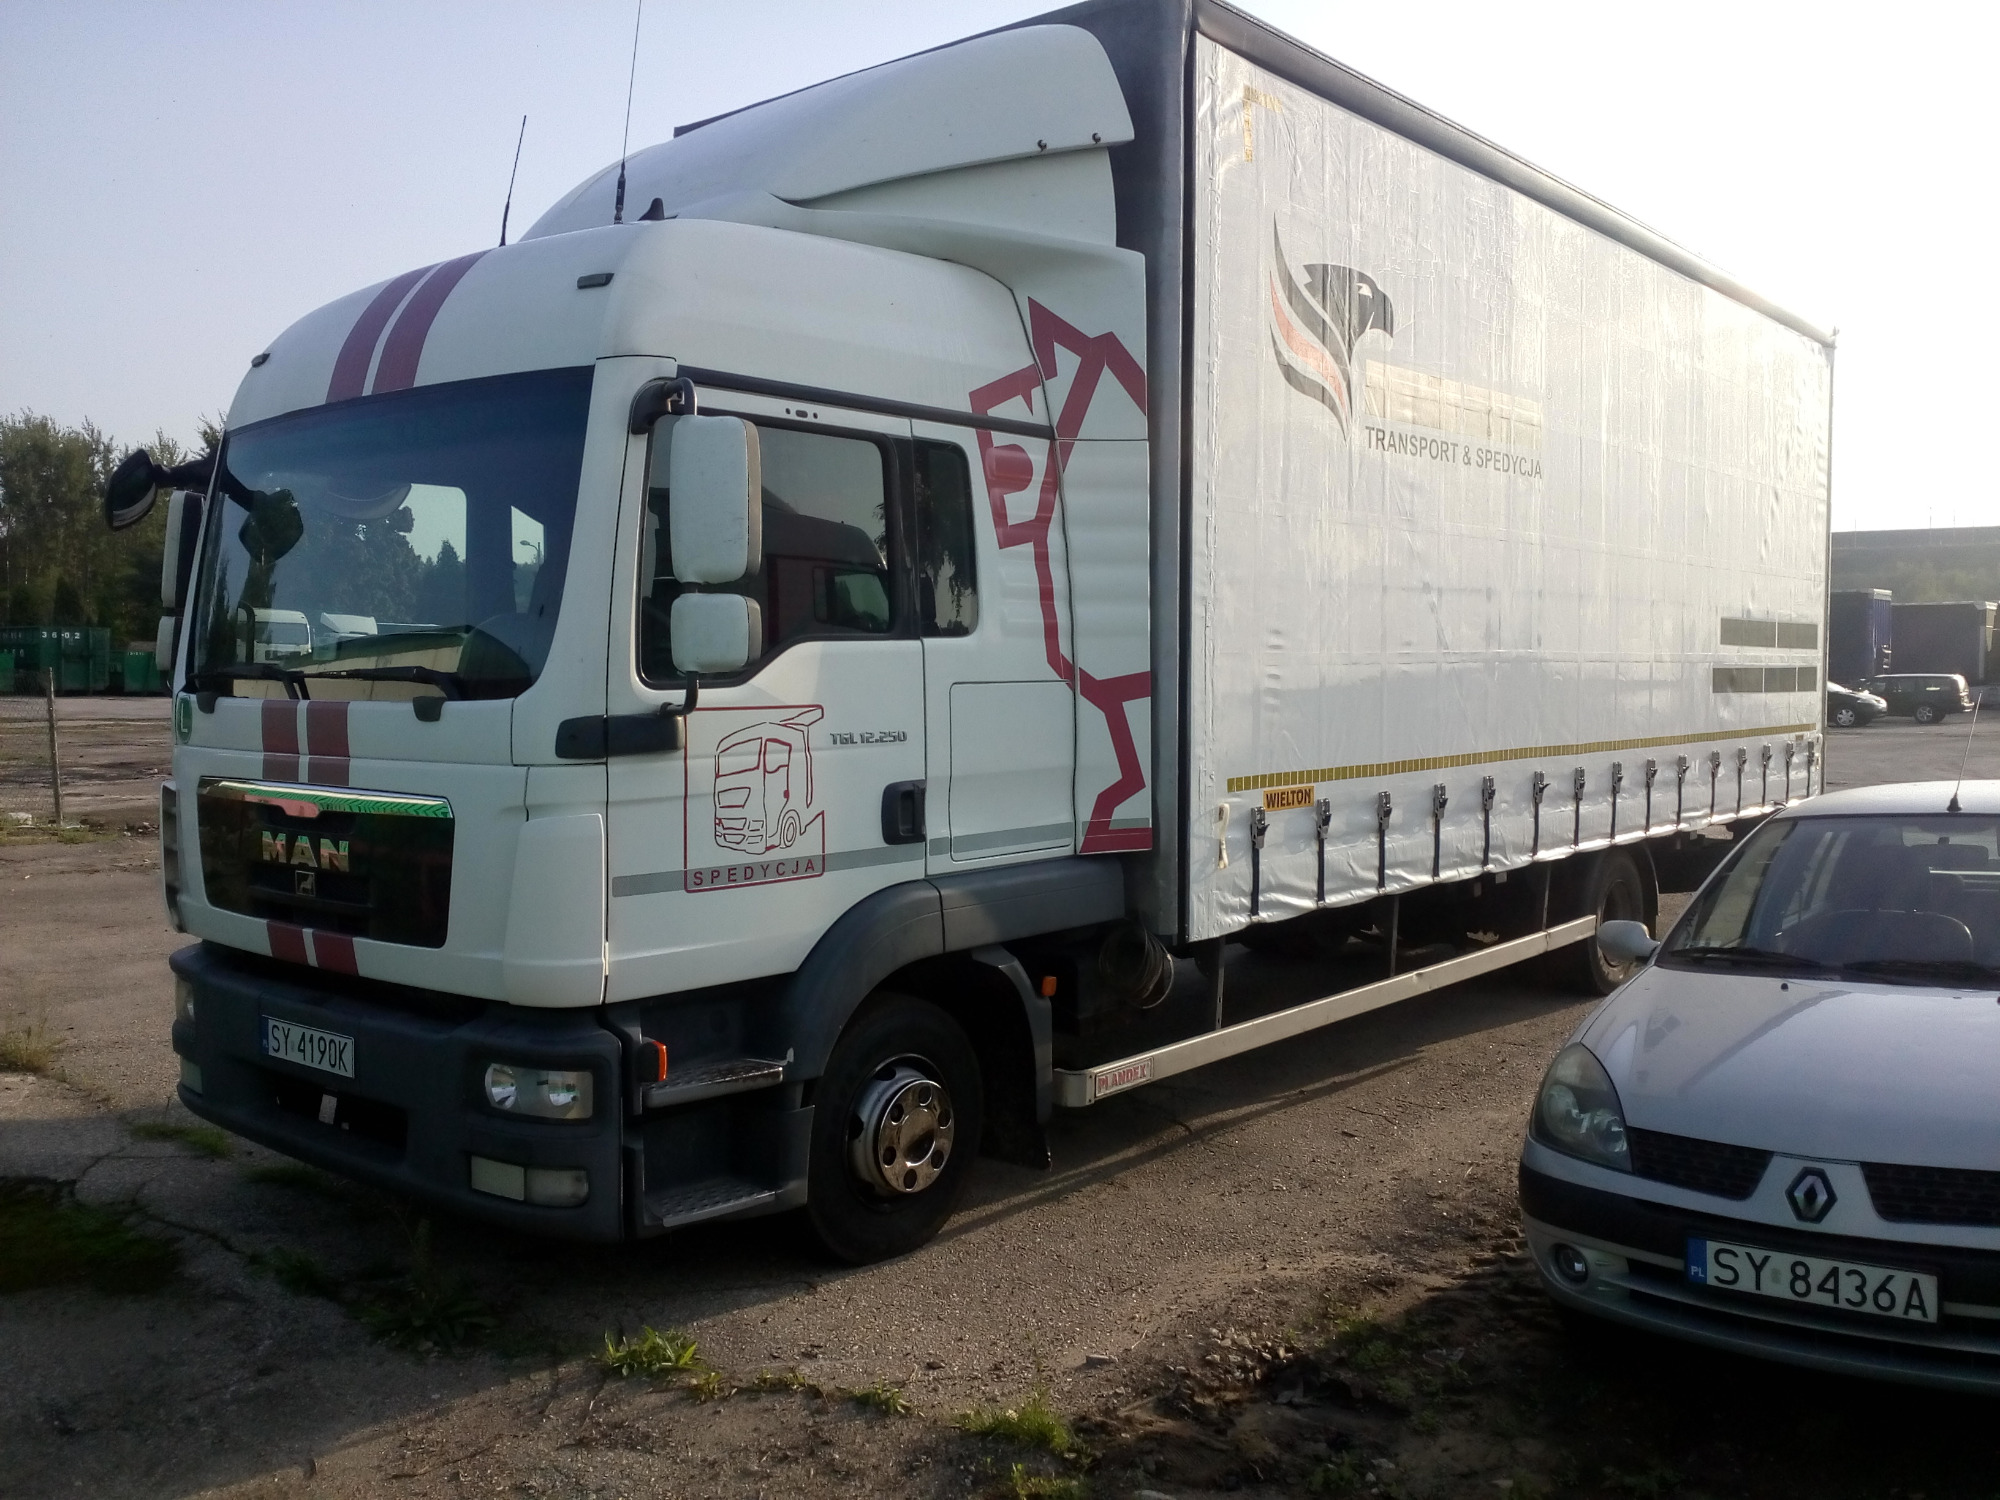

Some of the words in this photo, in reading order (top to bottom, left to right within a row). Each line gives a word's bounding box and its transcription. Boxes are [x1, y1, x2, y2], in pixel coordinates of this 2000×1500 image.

[1365, 425, 1459, 464] TRANSPORT
[1462, 445, 1472, 467] &
[1475, 447, 1543, 480] SPEDYCJA
[829, 732, 858, 745] TGL
[860, 730, 908, 744] 12.250
[1266, 788, 1312, 809] WIELTON
[261, 830, 350, 873] MAN
[692, 858, 816, 886] SPEDYCJA
[271, 1024, 291, 1056] SY
[297, 1031, 348, 1073] 4190K
[1690, 1264, 1705, 1278] PL
[1713, 1247, 1771, 1292] SY
[1789, 1260, 1929, 1320] 8436A
